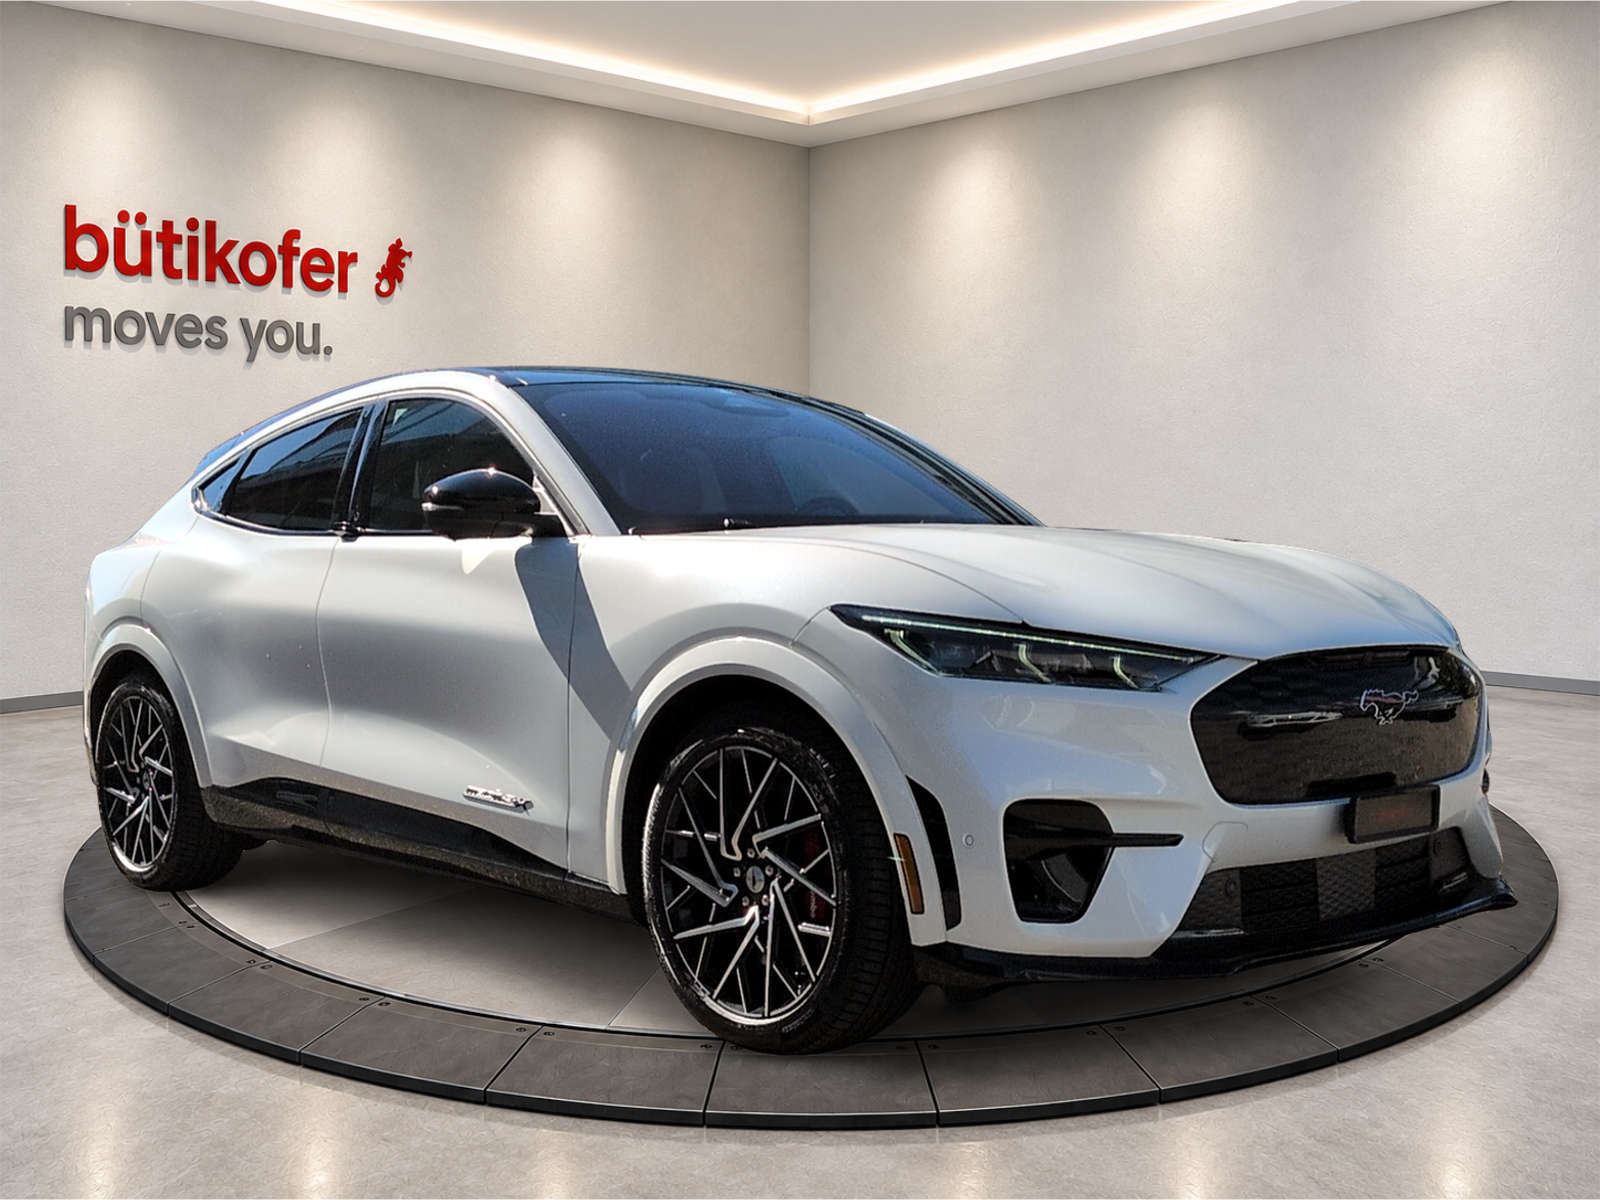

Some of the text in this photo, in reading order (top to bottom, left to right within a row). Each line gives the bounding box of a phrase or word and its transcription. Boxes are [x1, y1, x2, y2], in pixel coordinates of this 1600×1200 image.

[64, 204, 358, 293] bütikofer
[64, 305, 333, 362] moves you.
